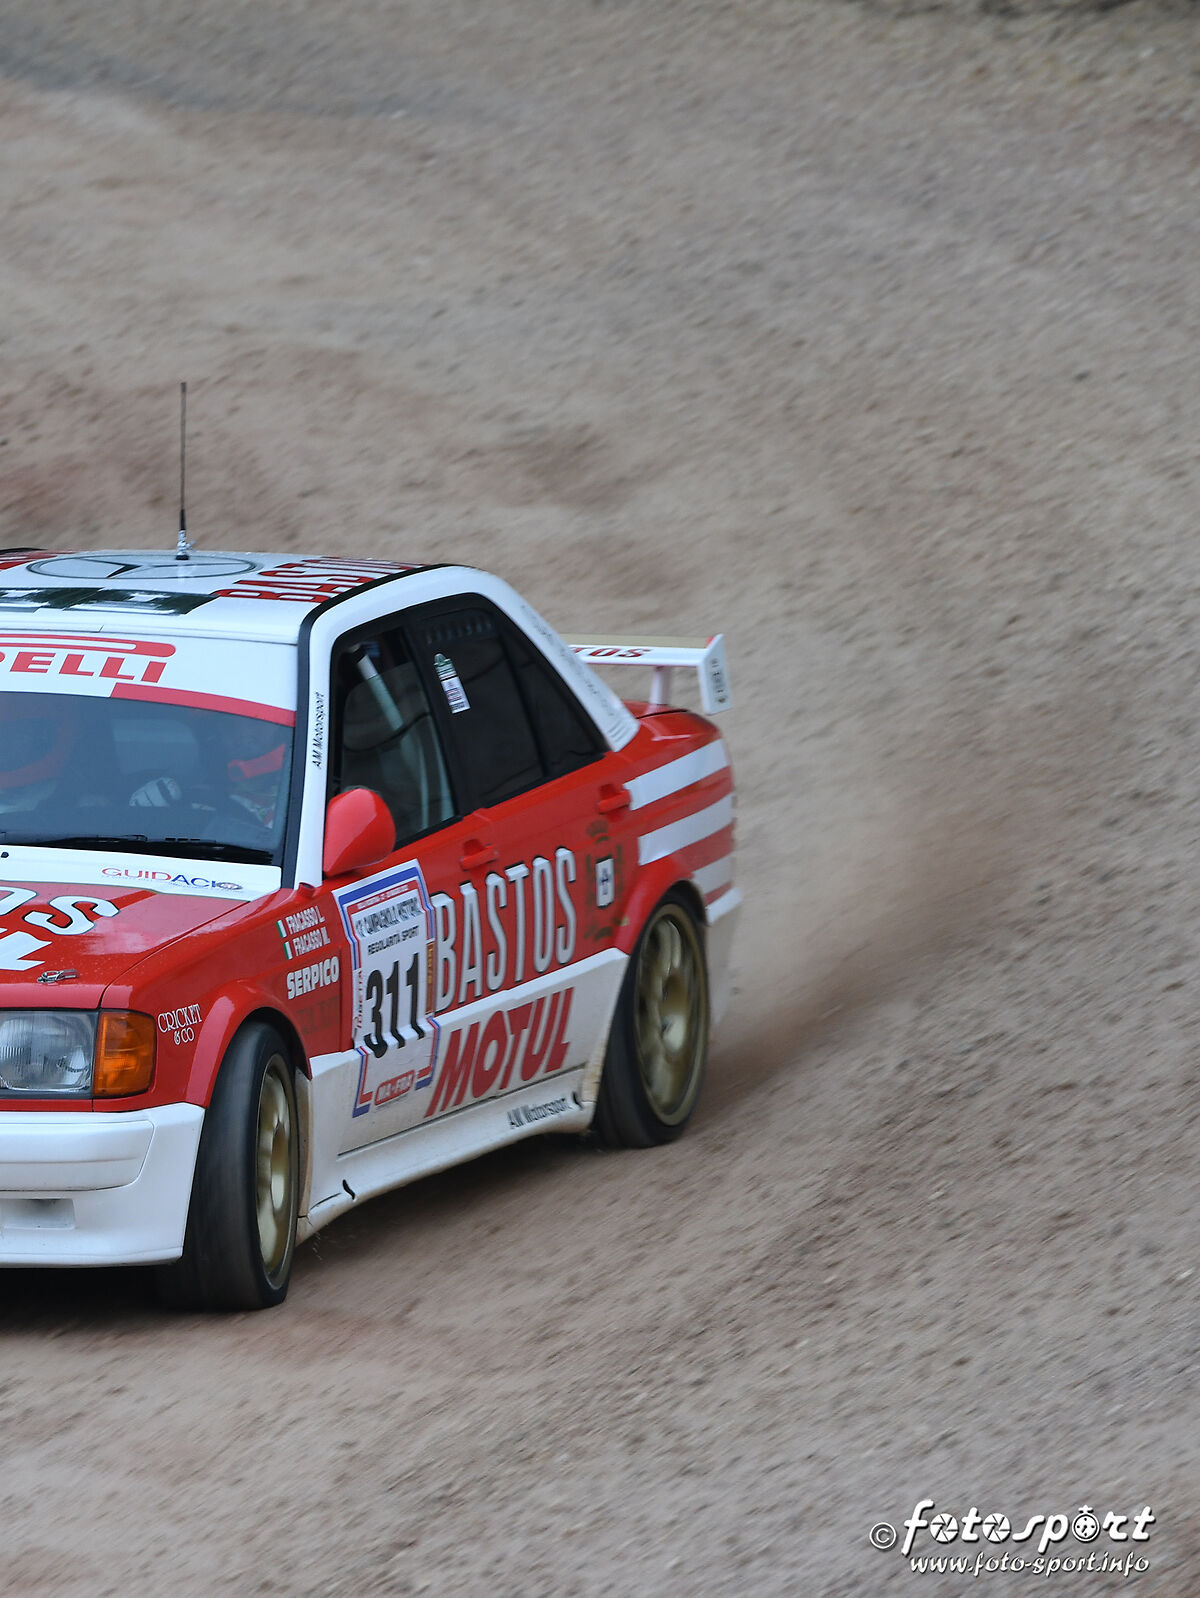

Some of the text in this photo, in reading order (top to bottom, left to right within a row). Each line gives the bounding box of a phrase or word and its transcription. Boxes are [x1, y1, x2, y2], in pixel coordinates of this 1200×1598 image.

[430, 847, 577, 1012] BASTOS
[287, 956, 340, 1000] SERPICO
[364, 952, 426, 1059] 311
[158, 1003, 202, 1033] CRICKET
[181, 1027, 195, 1043] CO
[424, 987, 574, 1118] MOTUL
